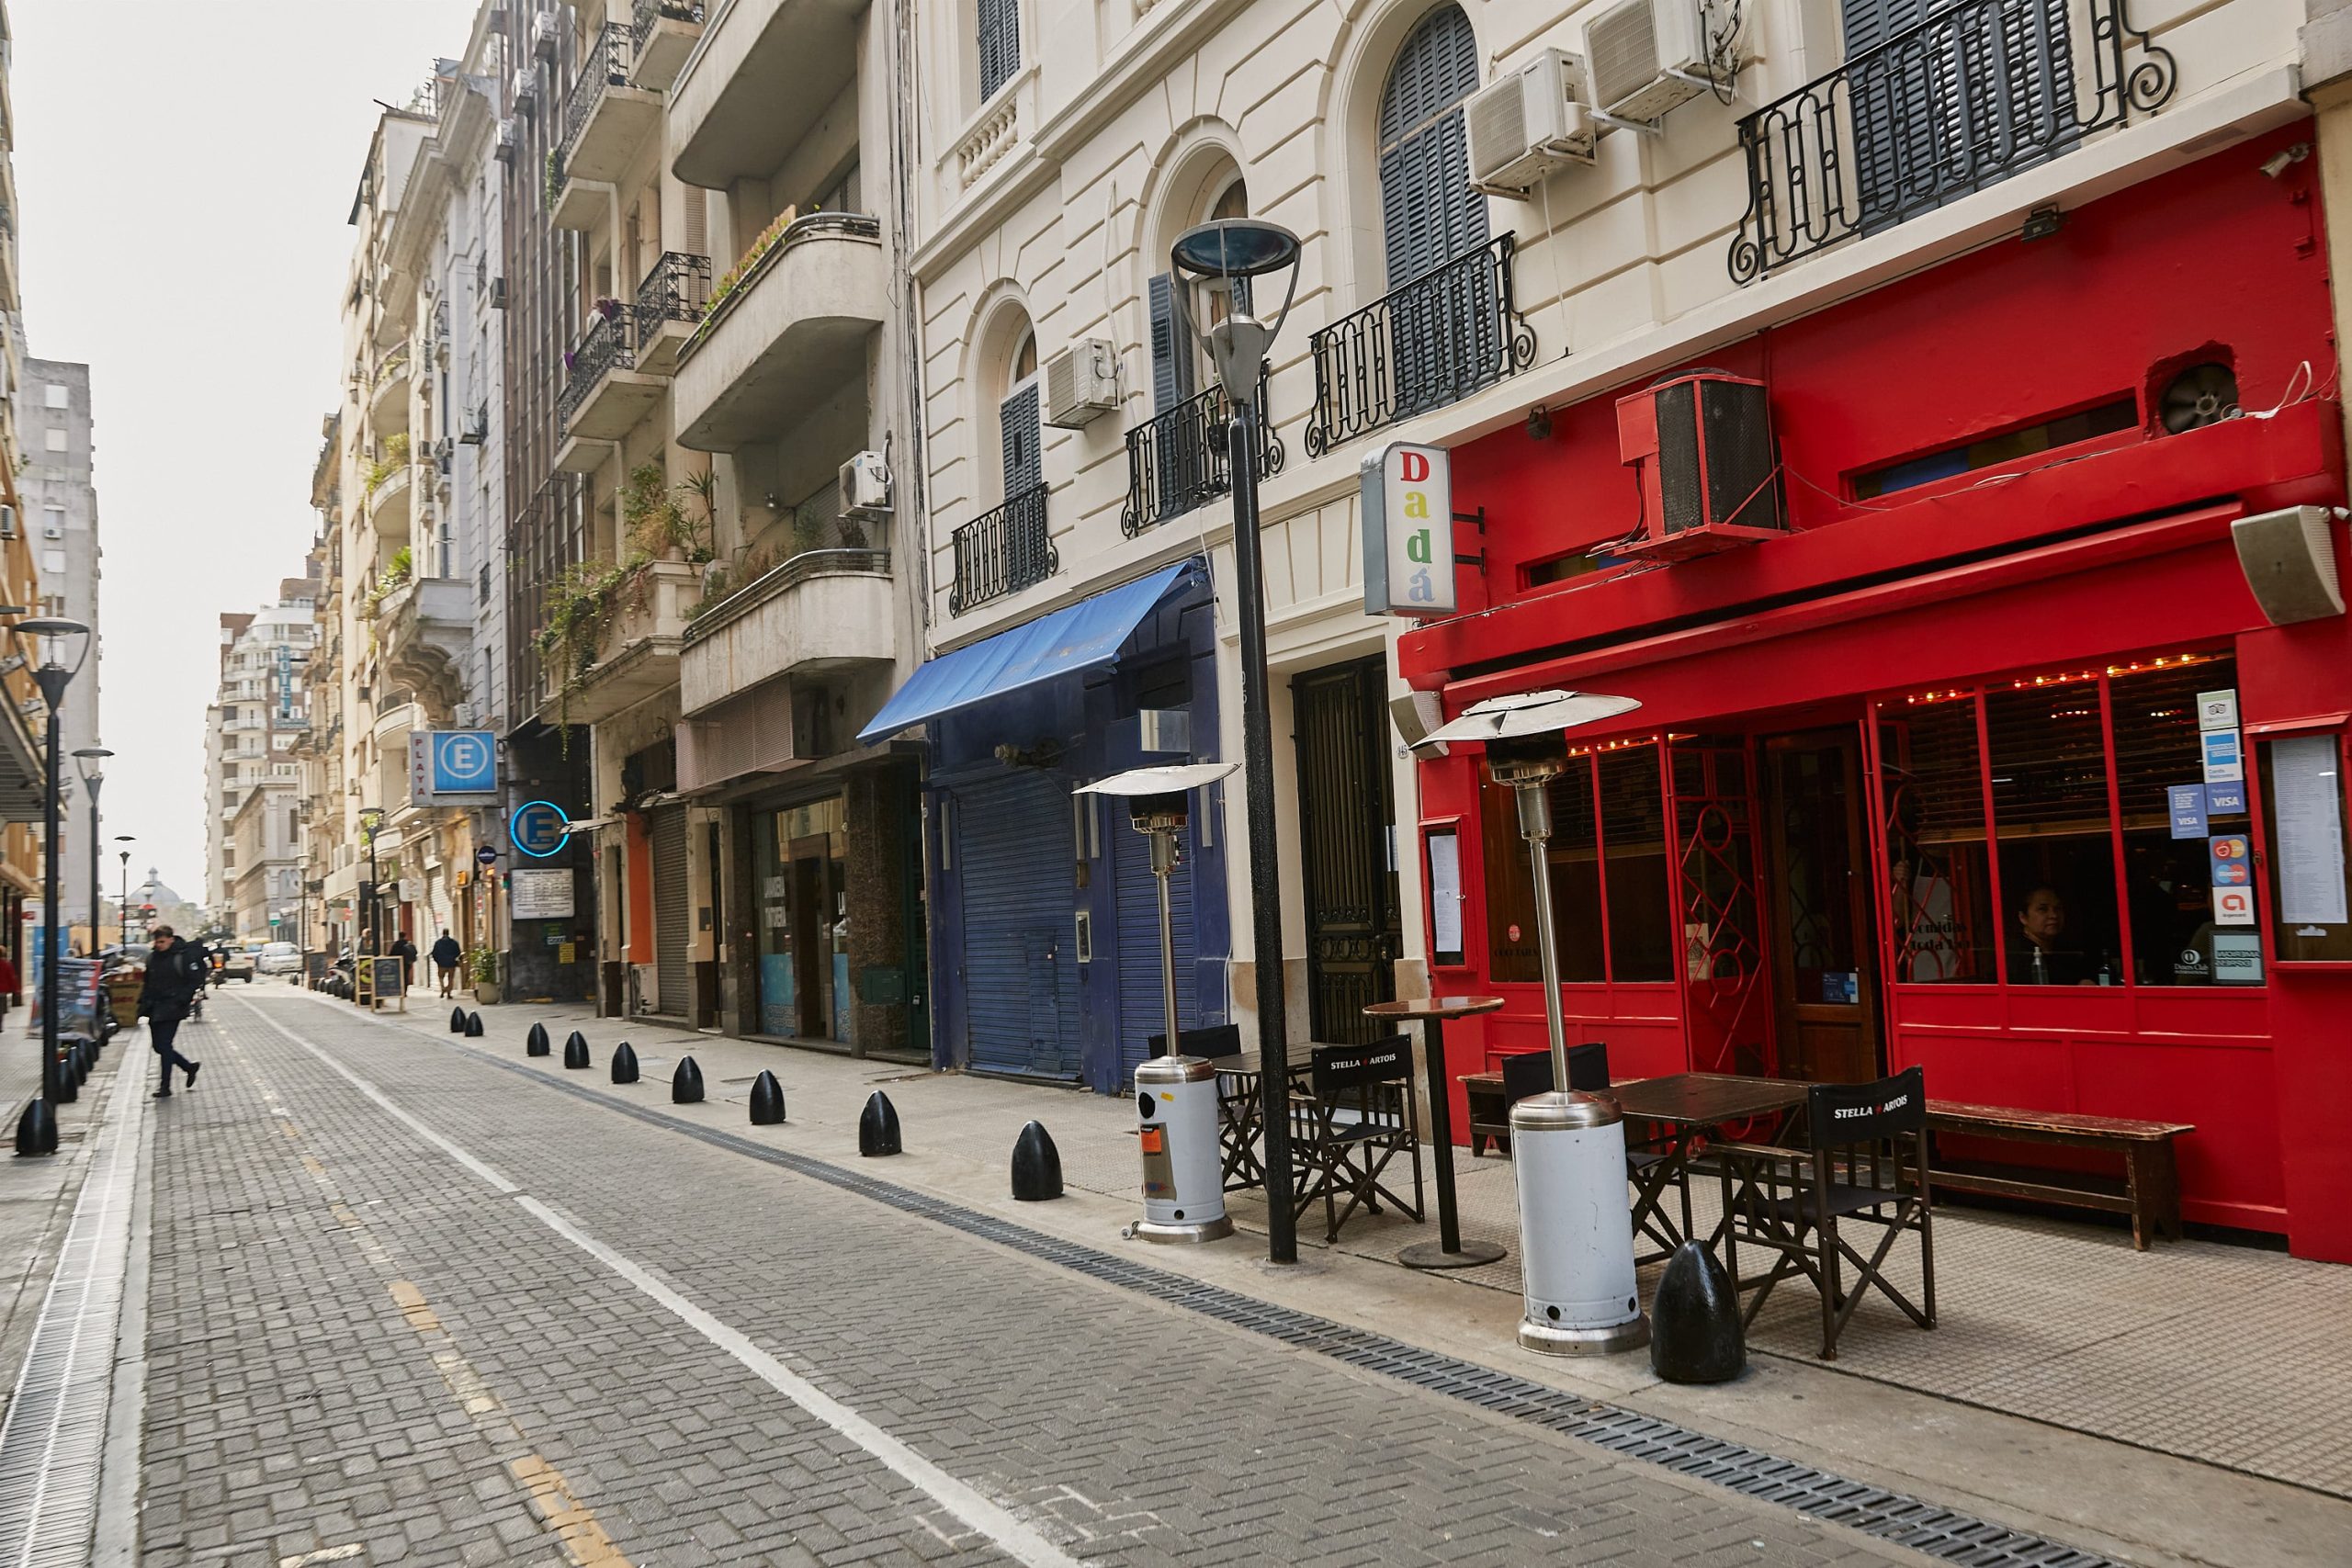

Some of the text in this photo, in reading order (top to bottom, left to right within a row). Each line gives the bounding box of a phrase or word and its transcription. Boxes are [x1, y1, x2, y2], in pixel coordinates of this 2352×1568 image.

[1399, 451, 1435, 603] Dadá
[278, 645, 291, 713] HOTEL
[415, 739, 425, 795] PLAYA
[454, 744, 475, 769] E
[2212, 796, 2239, 807] VISA
[2177, 817, 2199, 826] VISA
[1330, 1053, 1396, 1070] STELLA ARTOIS
[1834, 1094, 1907, 1119] STELLA ARTOIS
